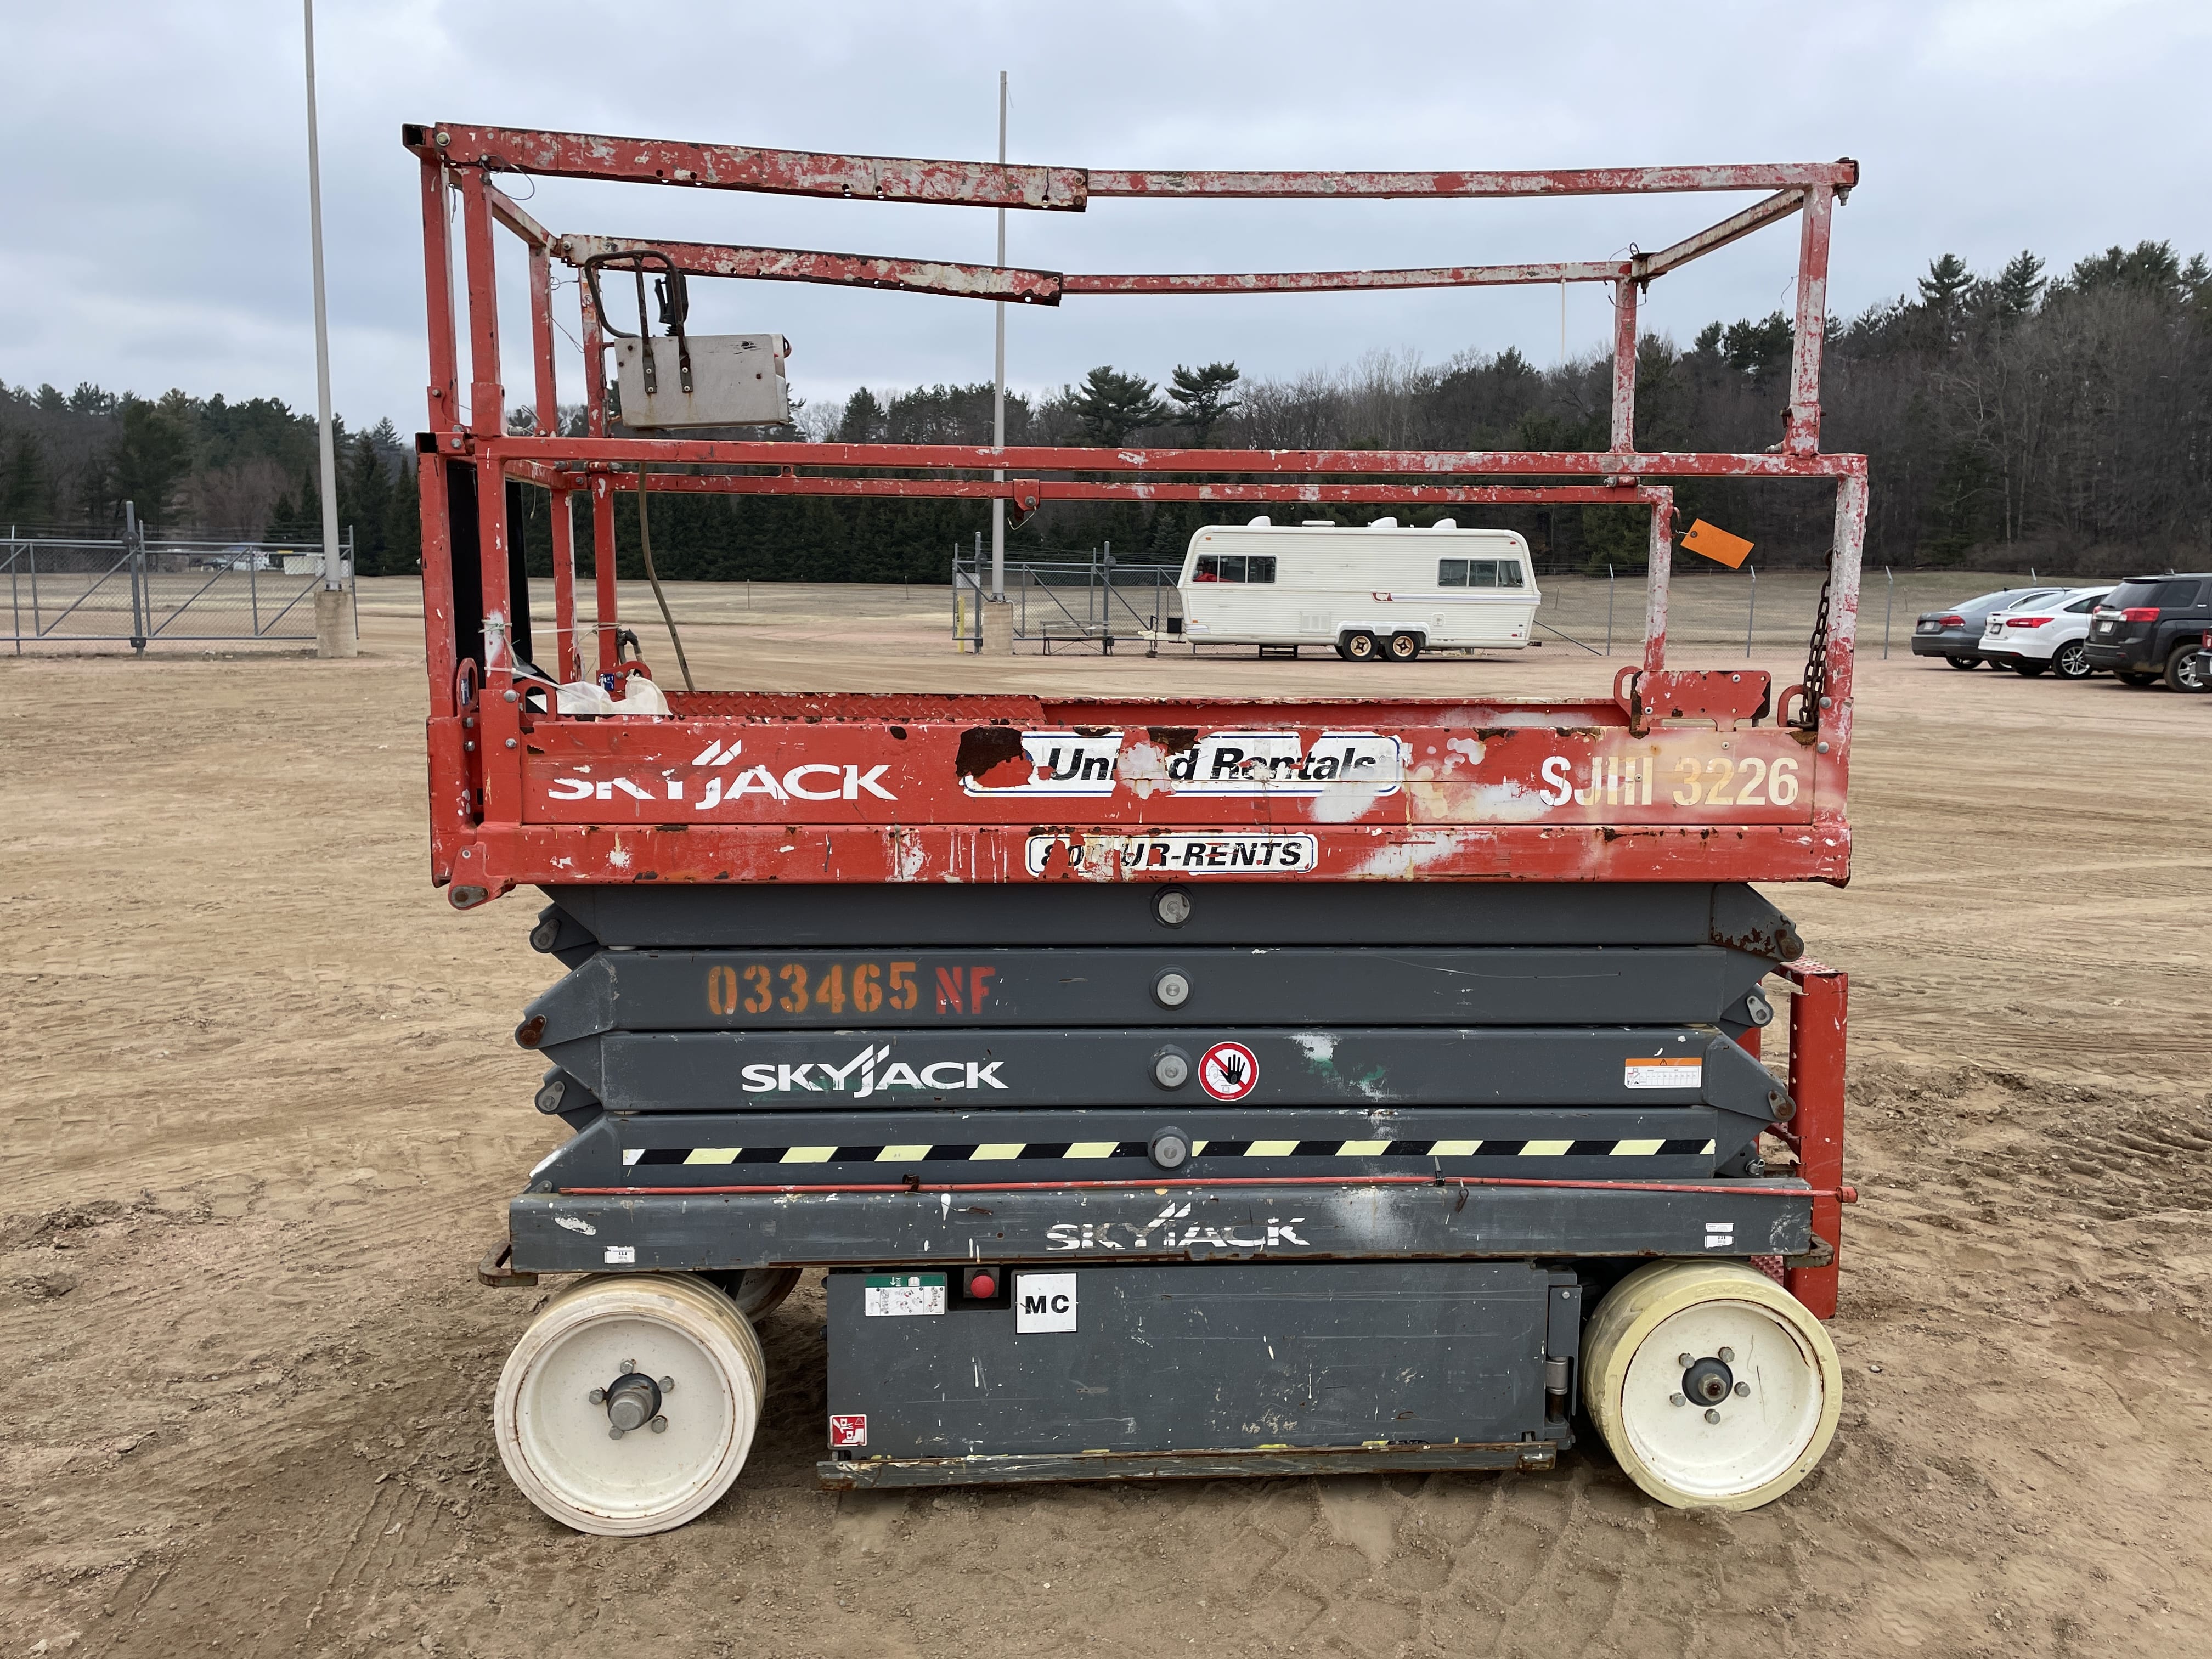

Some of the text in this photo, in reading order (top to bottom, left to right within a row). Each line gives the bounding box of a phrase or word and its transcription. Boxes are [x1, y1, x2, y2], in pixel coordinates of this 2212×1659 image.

[1210, 748, 1376, 780] Rentals
[1540, 756, 1799, 806] SJIII 3226
[708, 962, 996, 1015] 033465 NF
[741, 1043, 1009, 1098] SKYJACK
[1046, 1202, 1310, 1251] SKYJACK
[1025, 1295, 1069, 1314] MC
